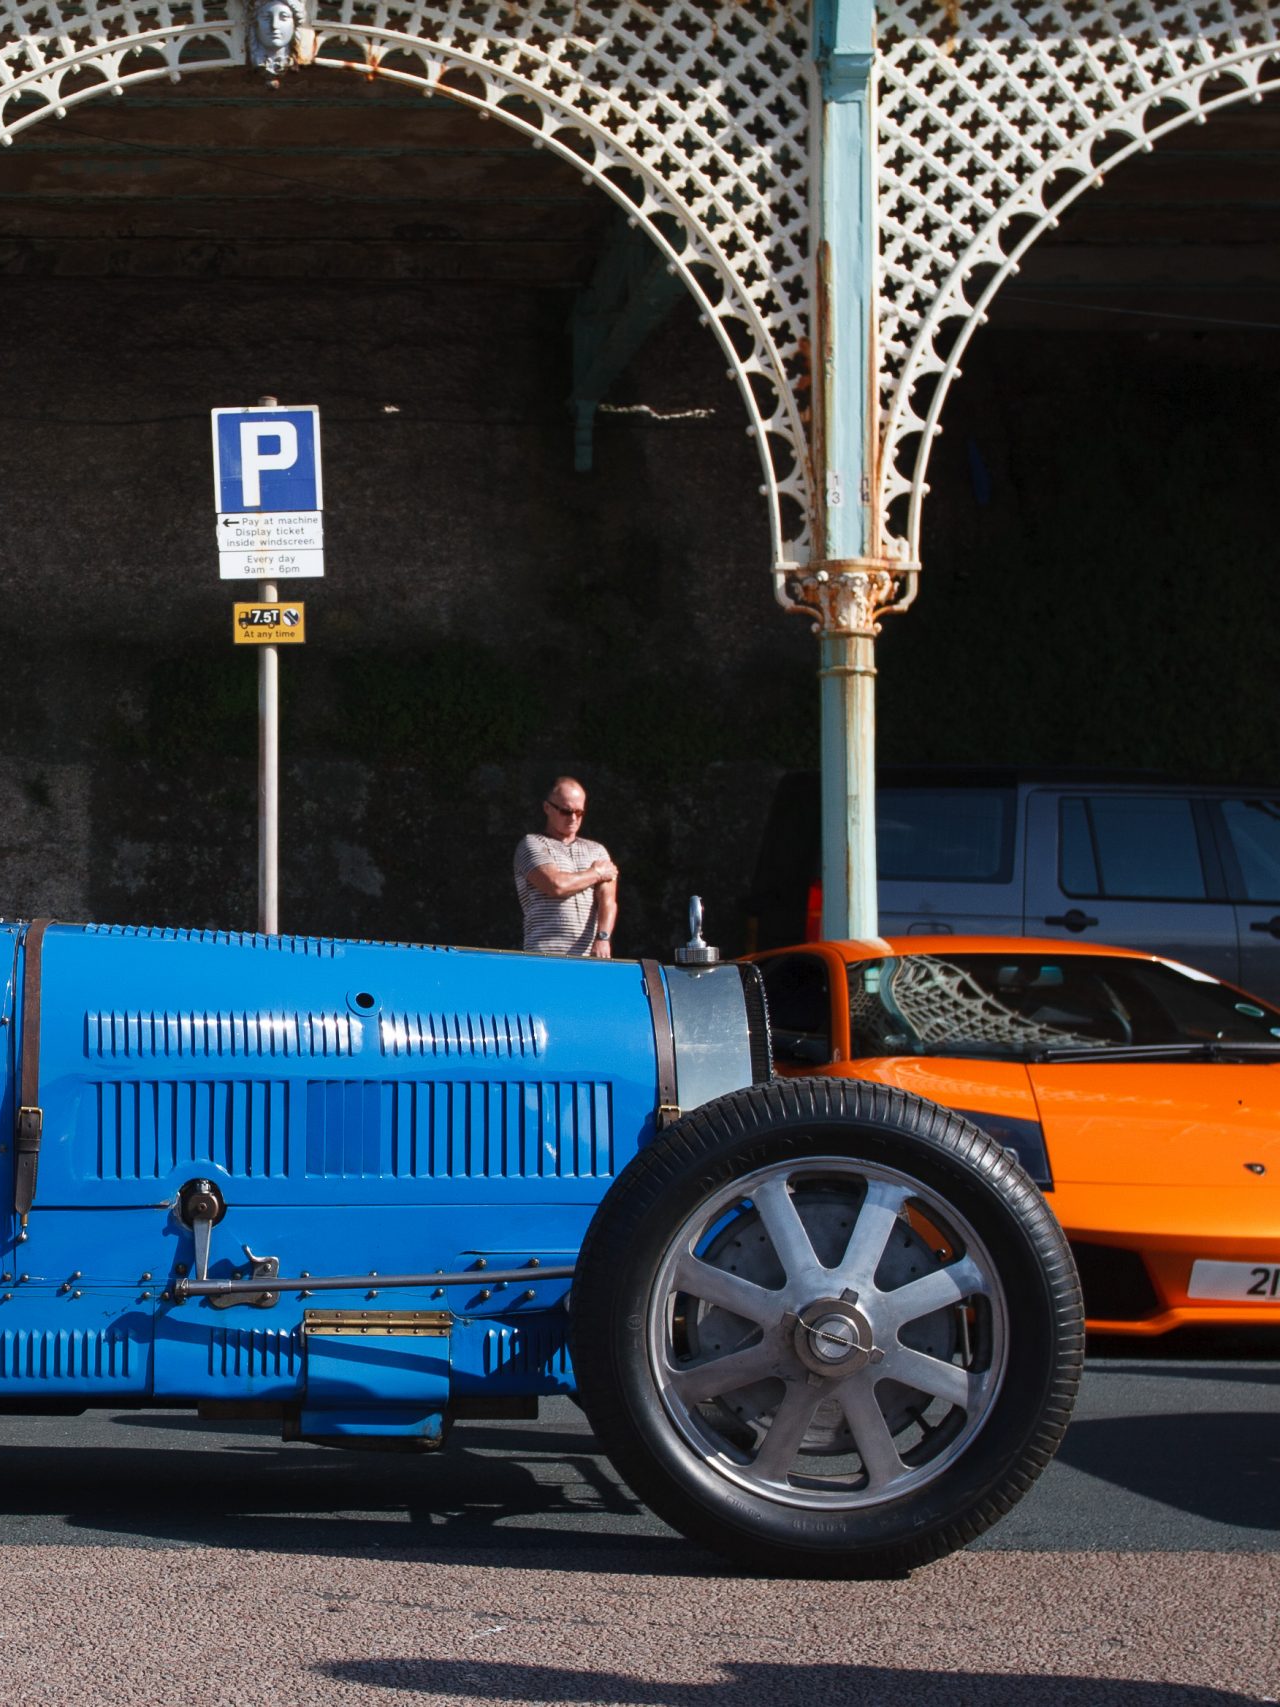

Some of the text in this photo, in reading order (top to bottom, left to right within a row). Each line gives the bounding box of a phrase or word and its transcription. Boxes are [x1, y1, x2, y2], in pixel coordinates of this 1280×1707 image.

[240, 421, 298, 507] P
[242, 517, 259, 526] Pay
[278, 515, 318, 524] machine
[235, 527, 305, 537] Display ticket
[226, 539, 255, 547] inside
[247, 554, 296, 564] Every day
[243, 565, 265, 574] 9am
[278, 564, 300, 573] 6pm
[251, 610, 279, 623] 7.5T
[243, 630, 254, 638] At
[257, 631, 272, 639] any
